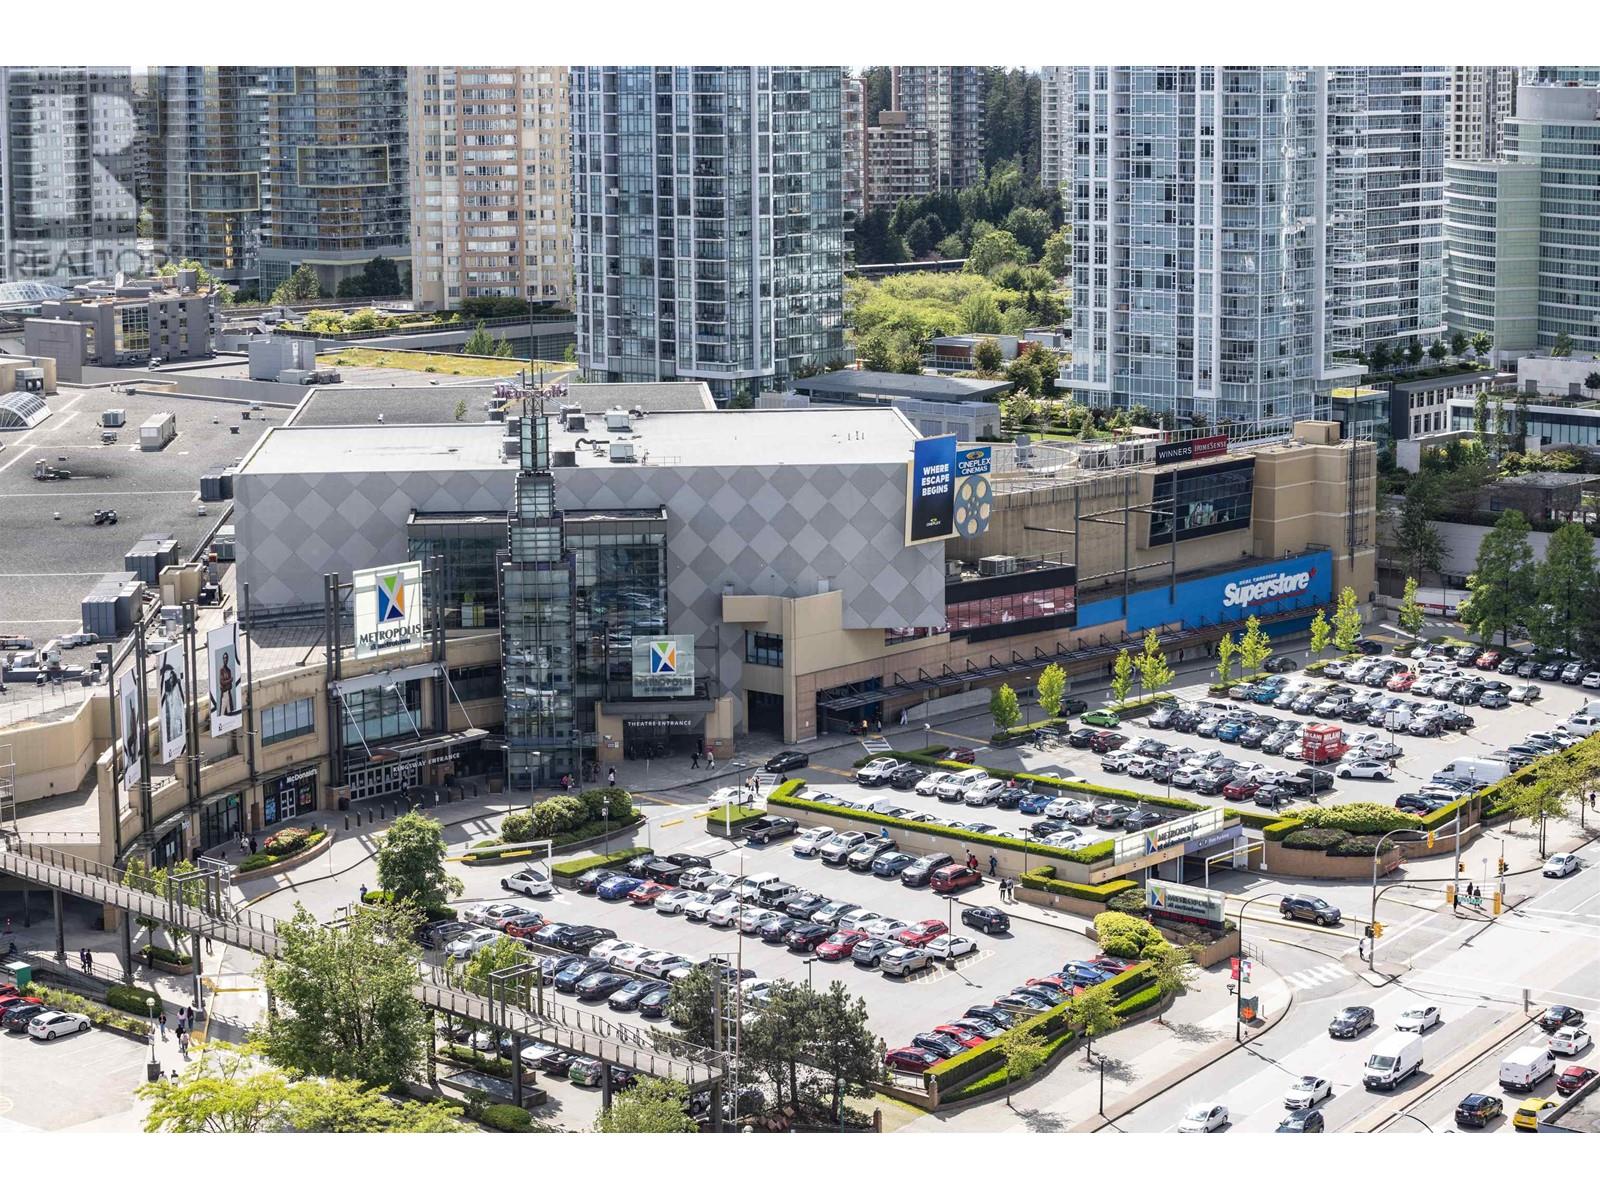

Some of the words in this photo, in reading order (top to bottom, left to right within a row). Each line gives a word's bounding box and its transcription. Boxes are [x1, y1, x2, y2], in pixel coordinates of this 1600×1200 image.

[1158, 447, 1192, 459] WINNERS
[923, 464, 949, 475] WHERE
[958, 458, 991, 469] CINEPLEX
[961, 465, 988, 475] CINEMAS
[922, 475, 949, 486] ESCAPE
[922, 485, 948, 496] BEGINS
[1223, 572, 1310, 607] Superstore
[360, 624, 421, 645] METROPOLIS
[393, 759, 427, 773] KINGSWAY
[428, 752, 461, 765] ENTRANCE
[286, 768, 318, 784] McDonald's
[1158, 822, 1199, 842] METROPOLIS
